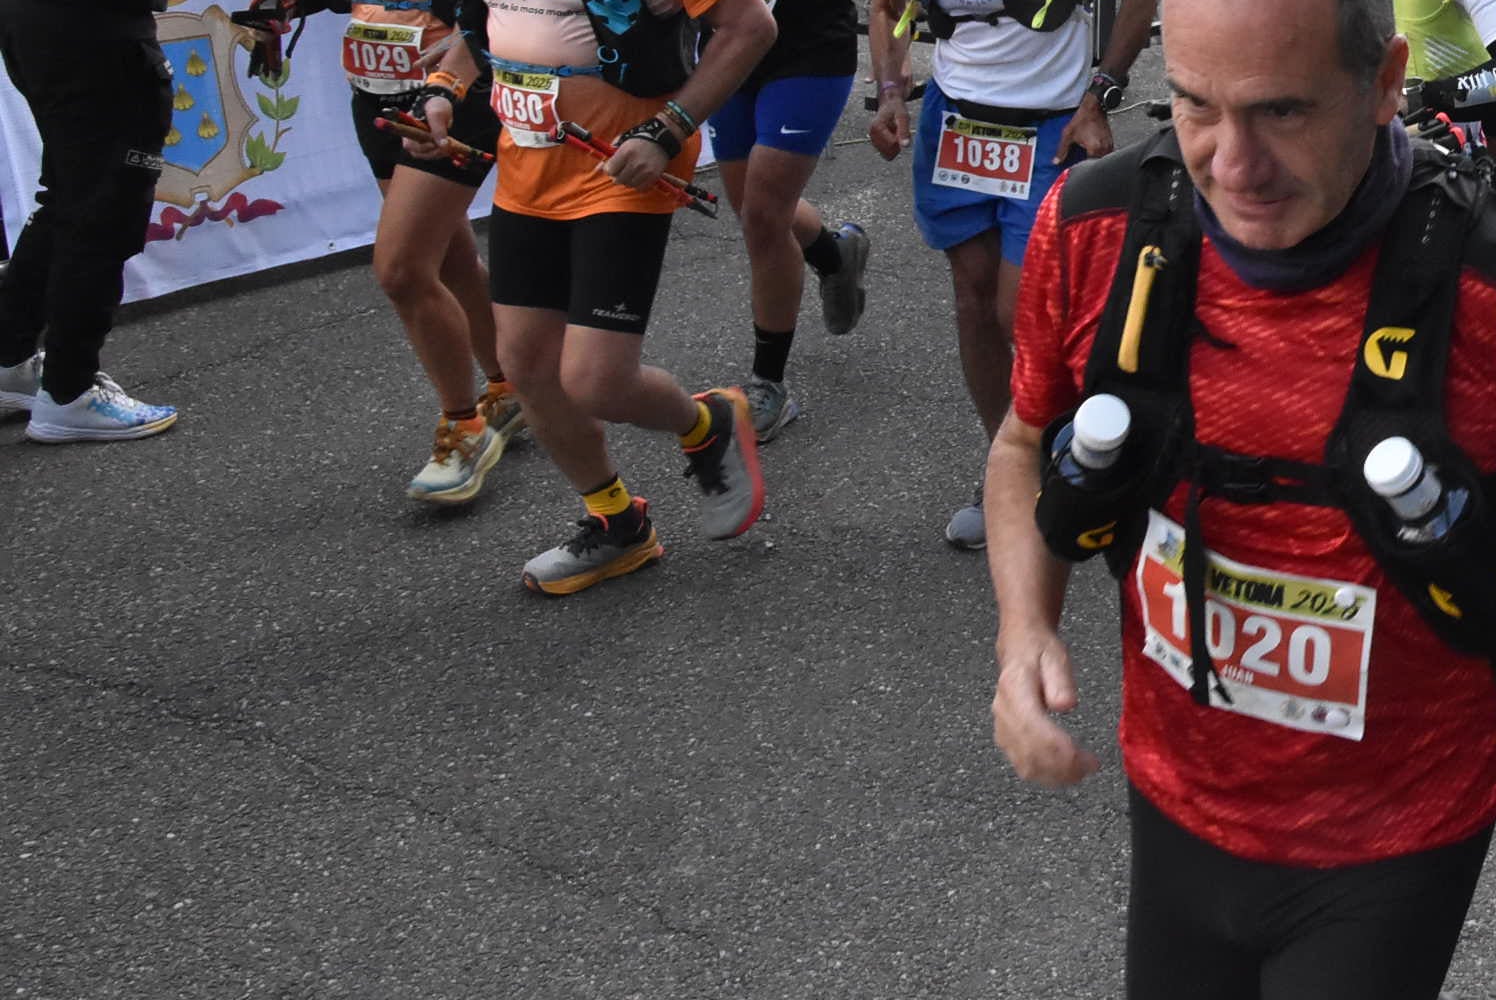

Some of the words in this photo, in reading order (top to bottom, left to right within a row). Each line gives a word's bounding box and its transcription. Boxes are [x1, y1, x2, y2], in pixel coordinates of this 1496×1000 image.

[349, 40, 411, 74] 1029
[953, 135, 1020, 173] 1038
[1208, 568, 1286, 608] VETONA
[1162, 582, 1333, 687] 1020
[1222, 664, 1254, 685] JUAN
